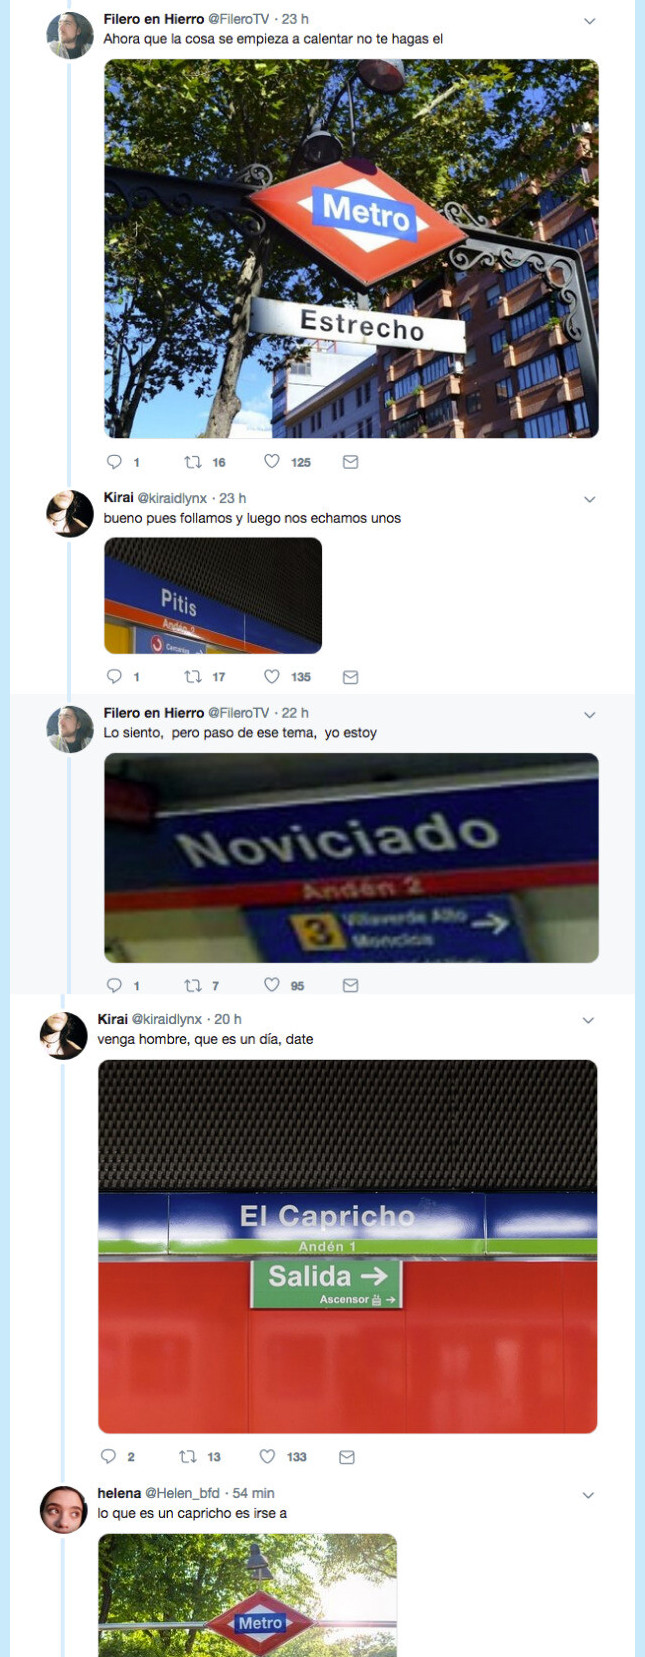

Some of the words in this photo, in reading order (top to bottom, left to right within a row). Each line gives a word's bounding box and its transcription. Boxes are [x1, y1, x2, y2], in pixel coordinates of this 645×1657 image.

[323, 192, 410, 232] Metro
[300, 309, 424, 342] Estrecho
[161, 588, 197, 617] Pitis
[176, 813, 499, 868] Noviciado
[303, 880, 397, 901] Andén
[303, 918, 333, 947] 3
[240, 1204, 267, 1227] El
[278, 1204, 416, 1232] Capricho
[298, 1241, 344, 1252] Andén
[349, 1241, 356, 1252] 1
[268, 1264, 351, 1287] Salida
[319, 1294, 369, 1304] Ascensor
[239, 1616, 283, 1630] Metro
